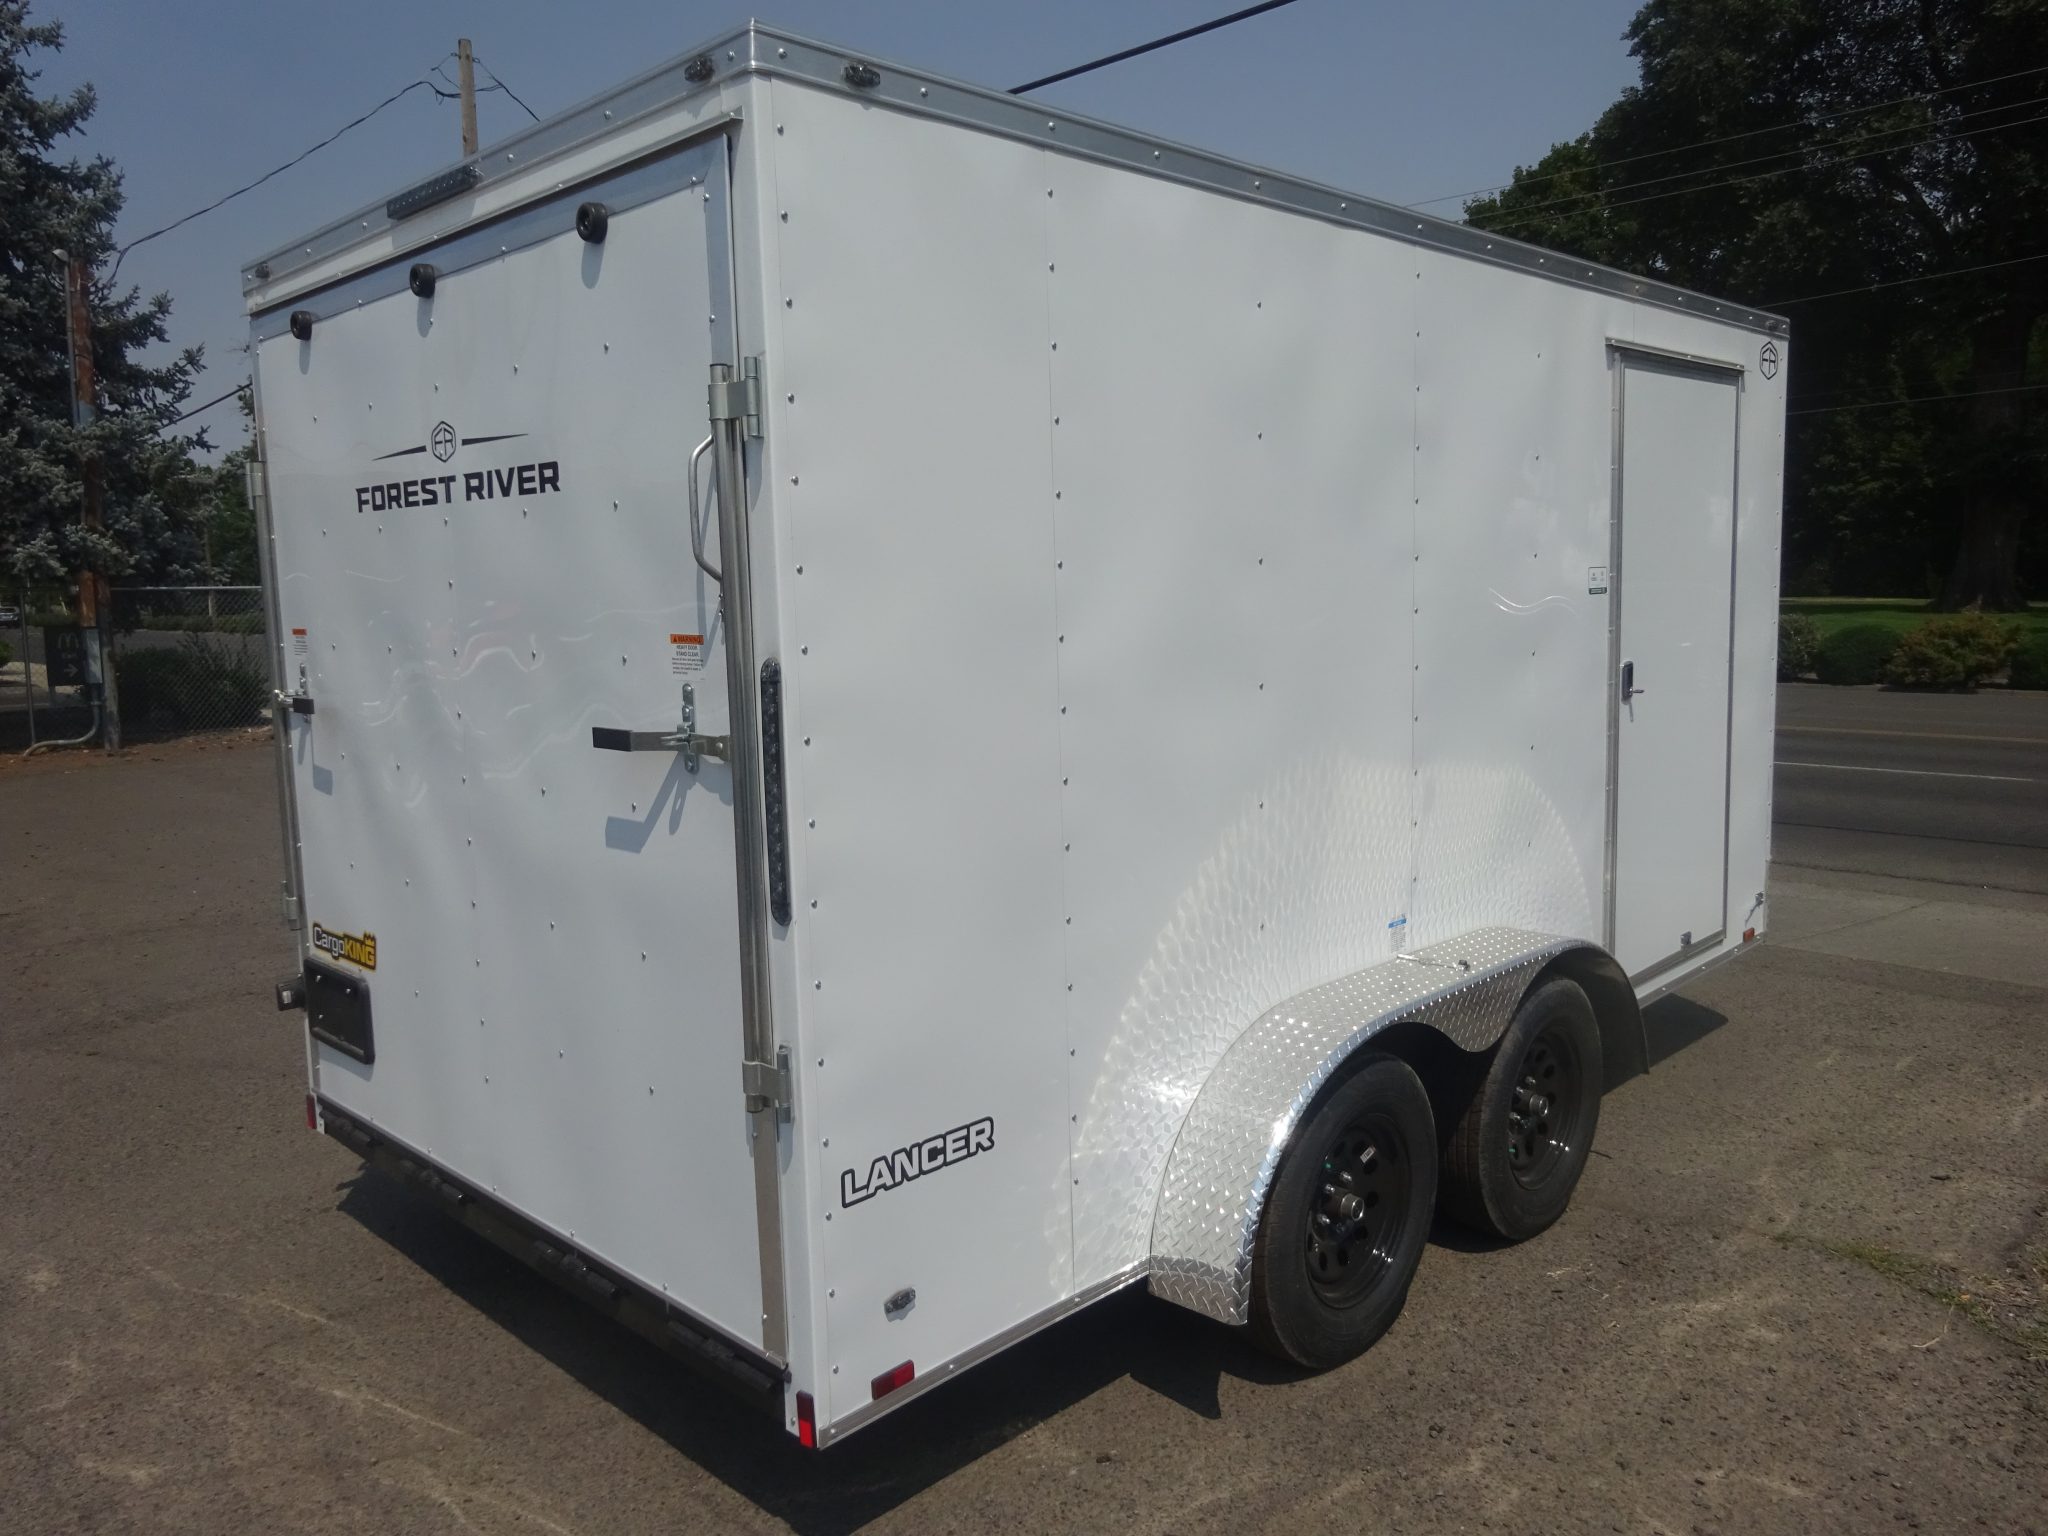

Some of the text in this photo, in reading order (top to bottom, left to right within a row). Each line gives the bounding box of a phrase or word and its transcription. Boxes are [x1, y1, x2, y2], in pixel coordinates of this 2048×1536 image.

[355, 460, 561, 513] FOREST RIVER
[841, 1116, 995, 1208] LANCER
